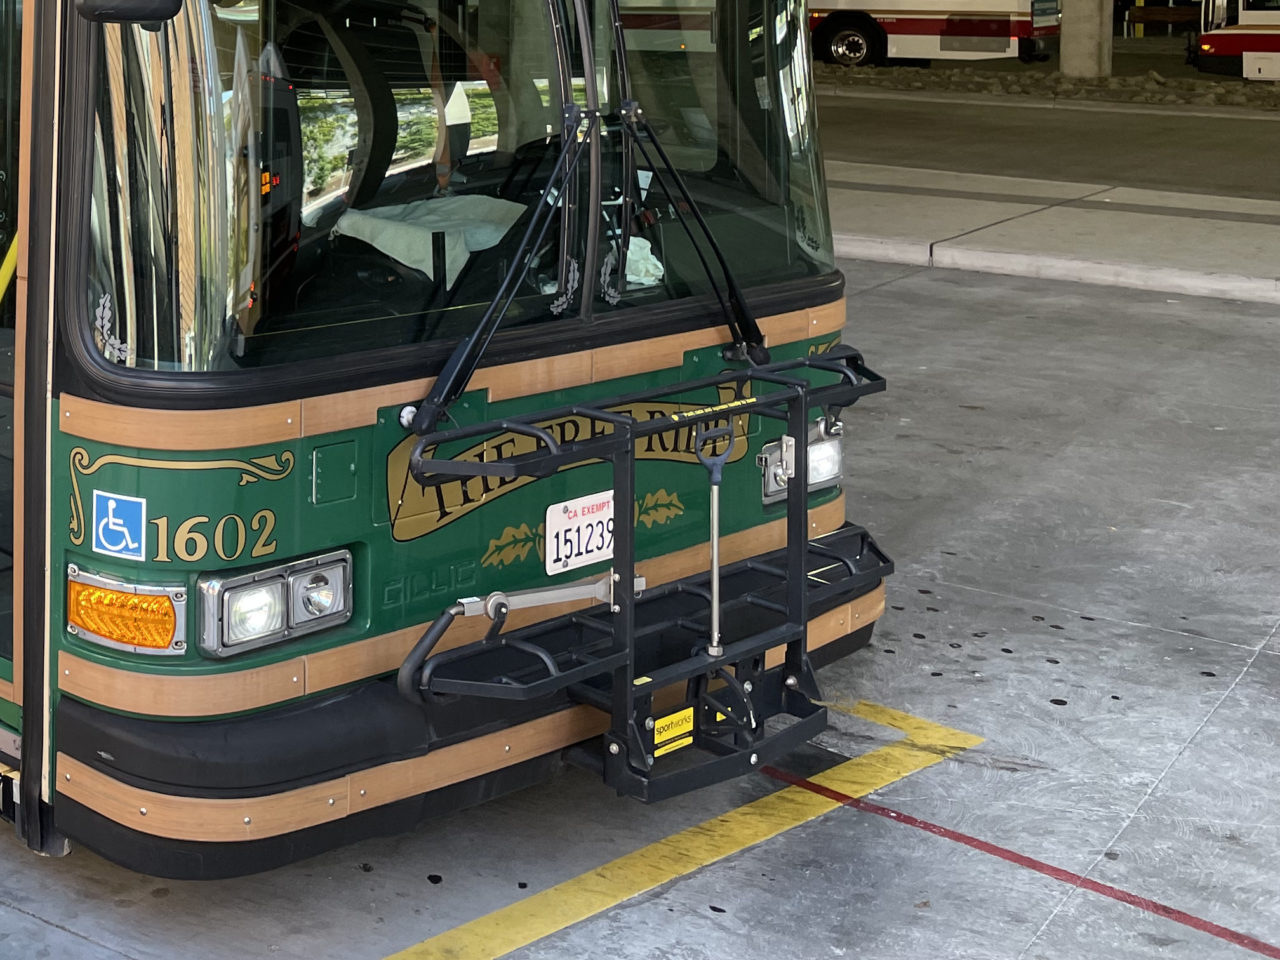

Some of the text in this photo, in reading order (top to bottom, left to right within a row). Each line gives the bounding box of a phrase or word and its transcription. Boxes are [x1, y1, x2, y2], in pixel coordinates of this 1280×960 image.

[568, 500, 611, 520] CA EXEMPT
[149, 508, 278, 563] 1602
[553, 518, 614, 563] 151239
[656, 715, 692, 736] sportworks
